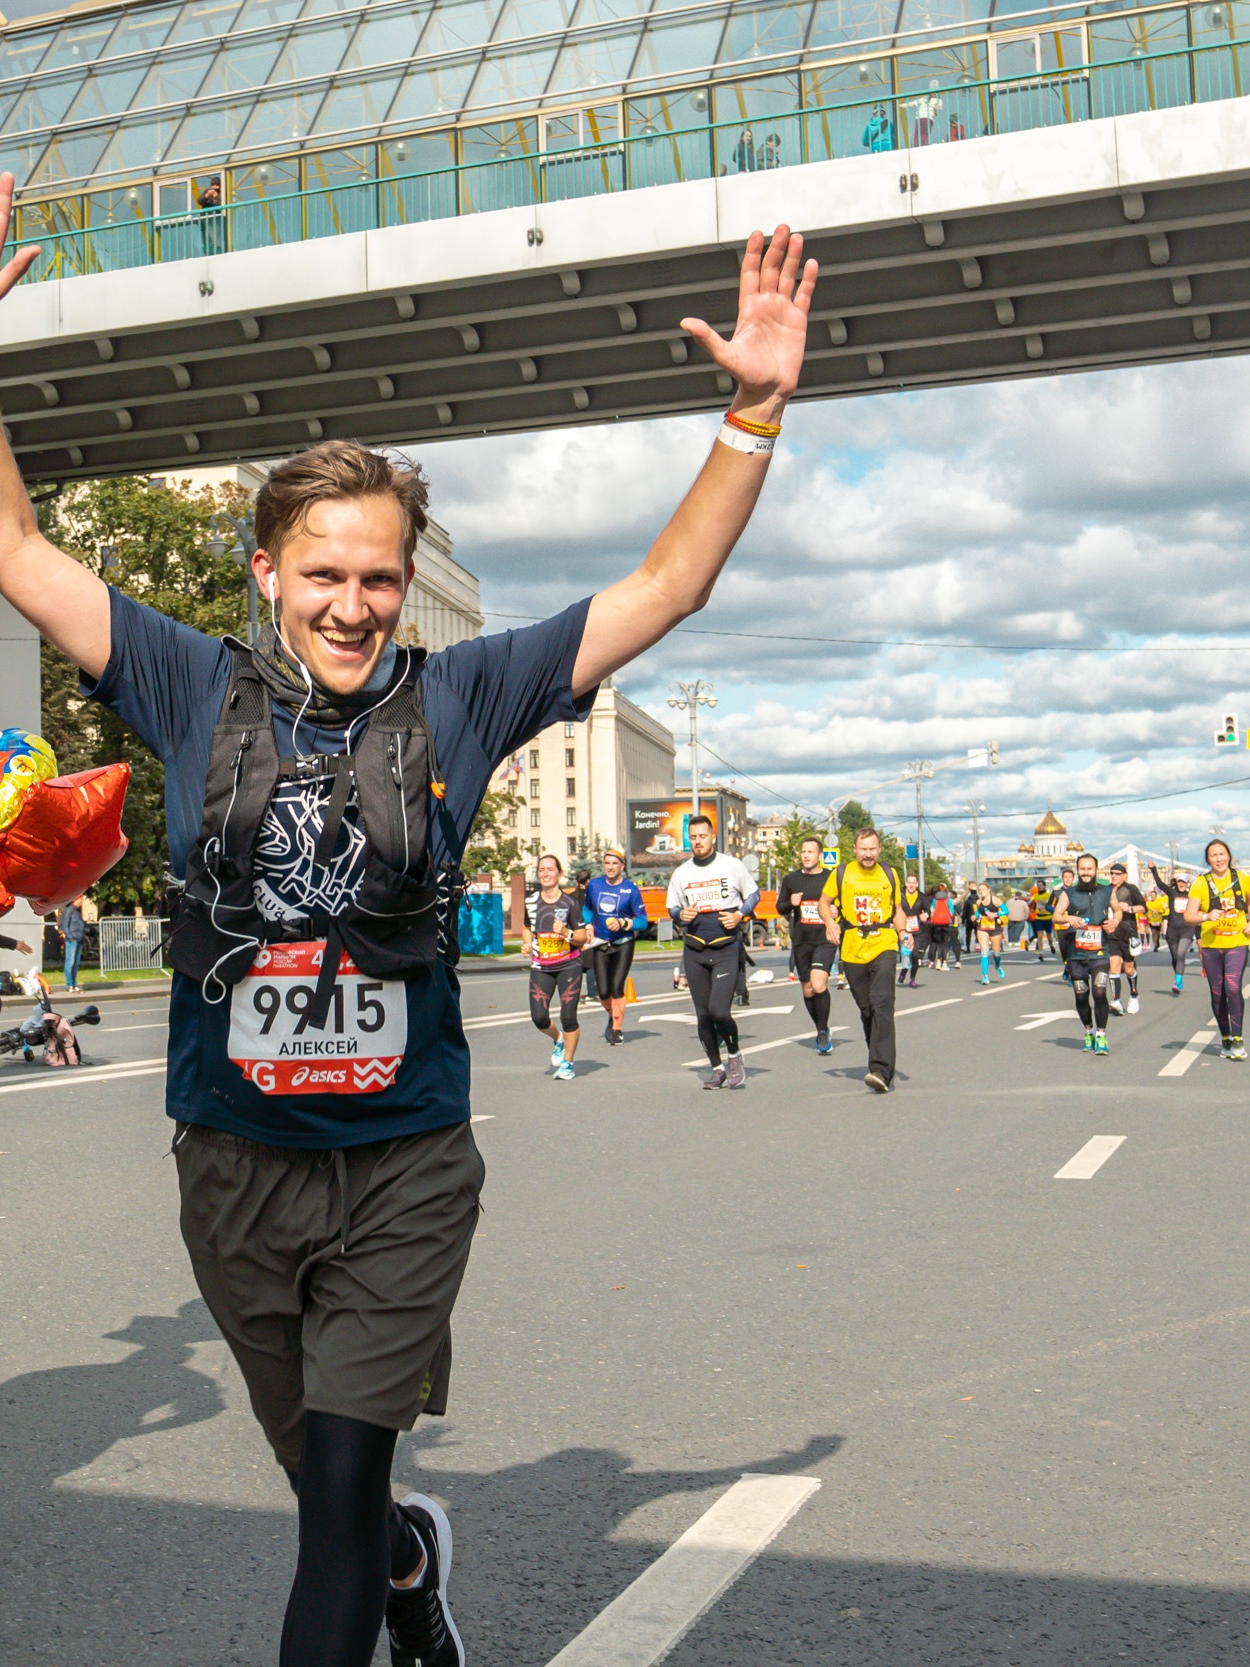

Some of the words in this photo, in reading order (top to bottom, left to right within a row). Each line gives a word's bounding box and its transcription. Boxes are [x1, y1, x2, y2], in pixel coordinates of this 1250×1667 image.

[634, 810, 671, 819] Конечно,
[634, 820, 660, 829] Jardin!
[1081, 931, 1096, 940] 661
[541, 939, 565, 948] 9287
[252, 982, 386, 1035] 9915
[278, 1037, 359, 1056] АЛЕКСЕЙ
[251, 1061, 276, 1091] G
[308, 1068, 348, 1083] asics
